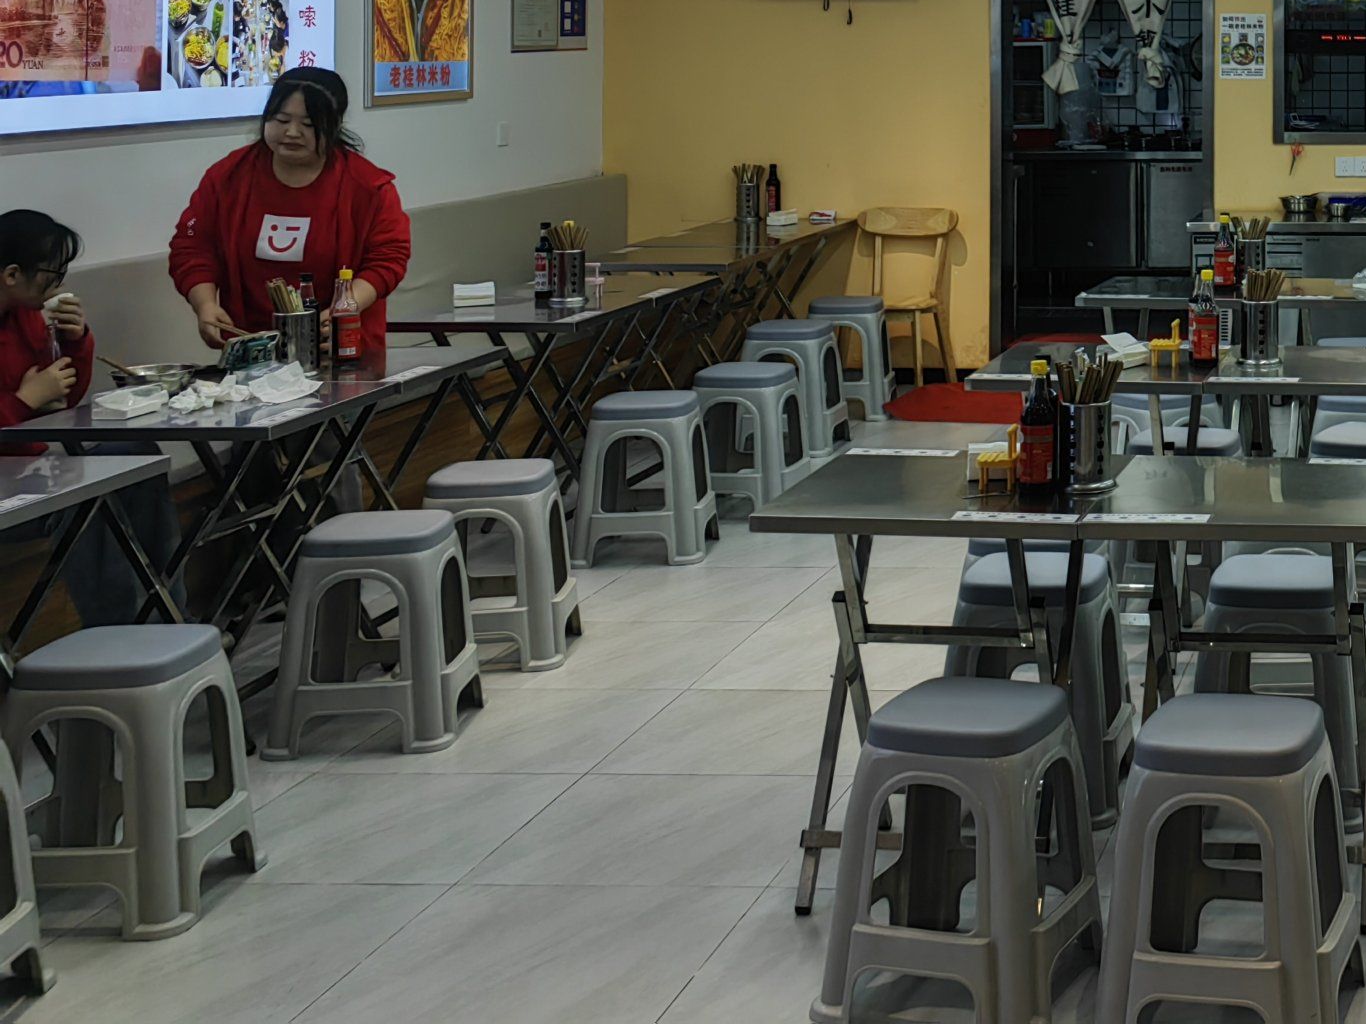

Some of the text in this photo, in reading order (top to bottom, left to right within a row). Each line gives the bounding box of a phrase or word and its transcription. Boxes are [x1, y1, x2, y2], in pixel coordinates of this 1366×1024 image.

[22, 60, 44, 70] YUAN
[390, 64, 451, 88] 老桂林米粉
